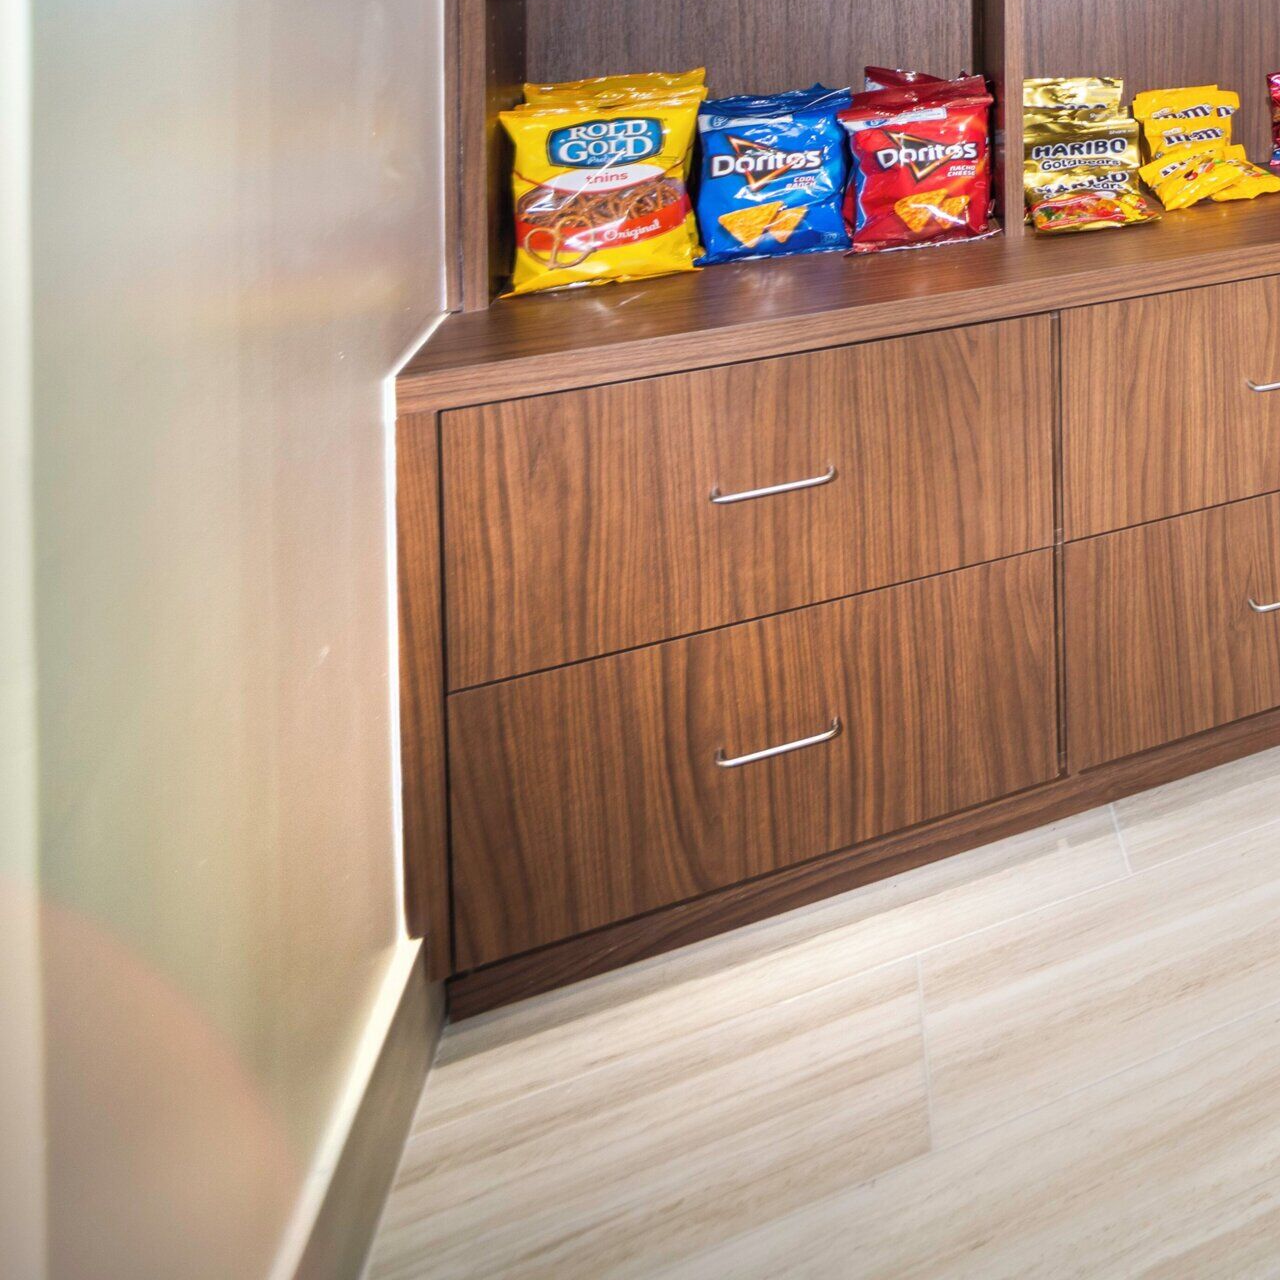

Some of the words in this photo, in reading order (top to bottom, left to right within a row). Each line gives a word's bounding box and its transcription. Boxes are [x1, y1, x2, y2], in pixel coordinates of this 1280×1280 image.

[570, 119, 648, 140] ROLD
[559, 136, 653, 162] GOLD
[877, 141, 978, 169] Doritos
[1034, 139, 1127, 158] HARIBO
[712, 149, 822, 177] Doritos
[603, 218, 661, 241] Original
